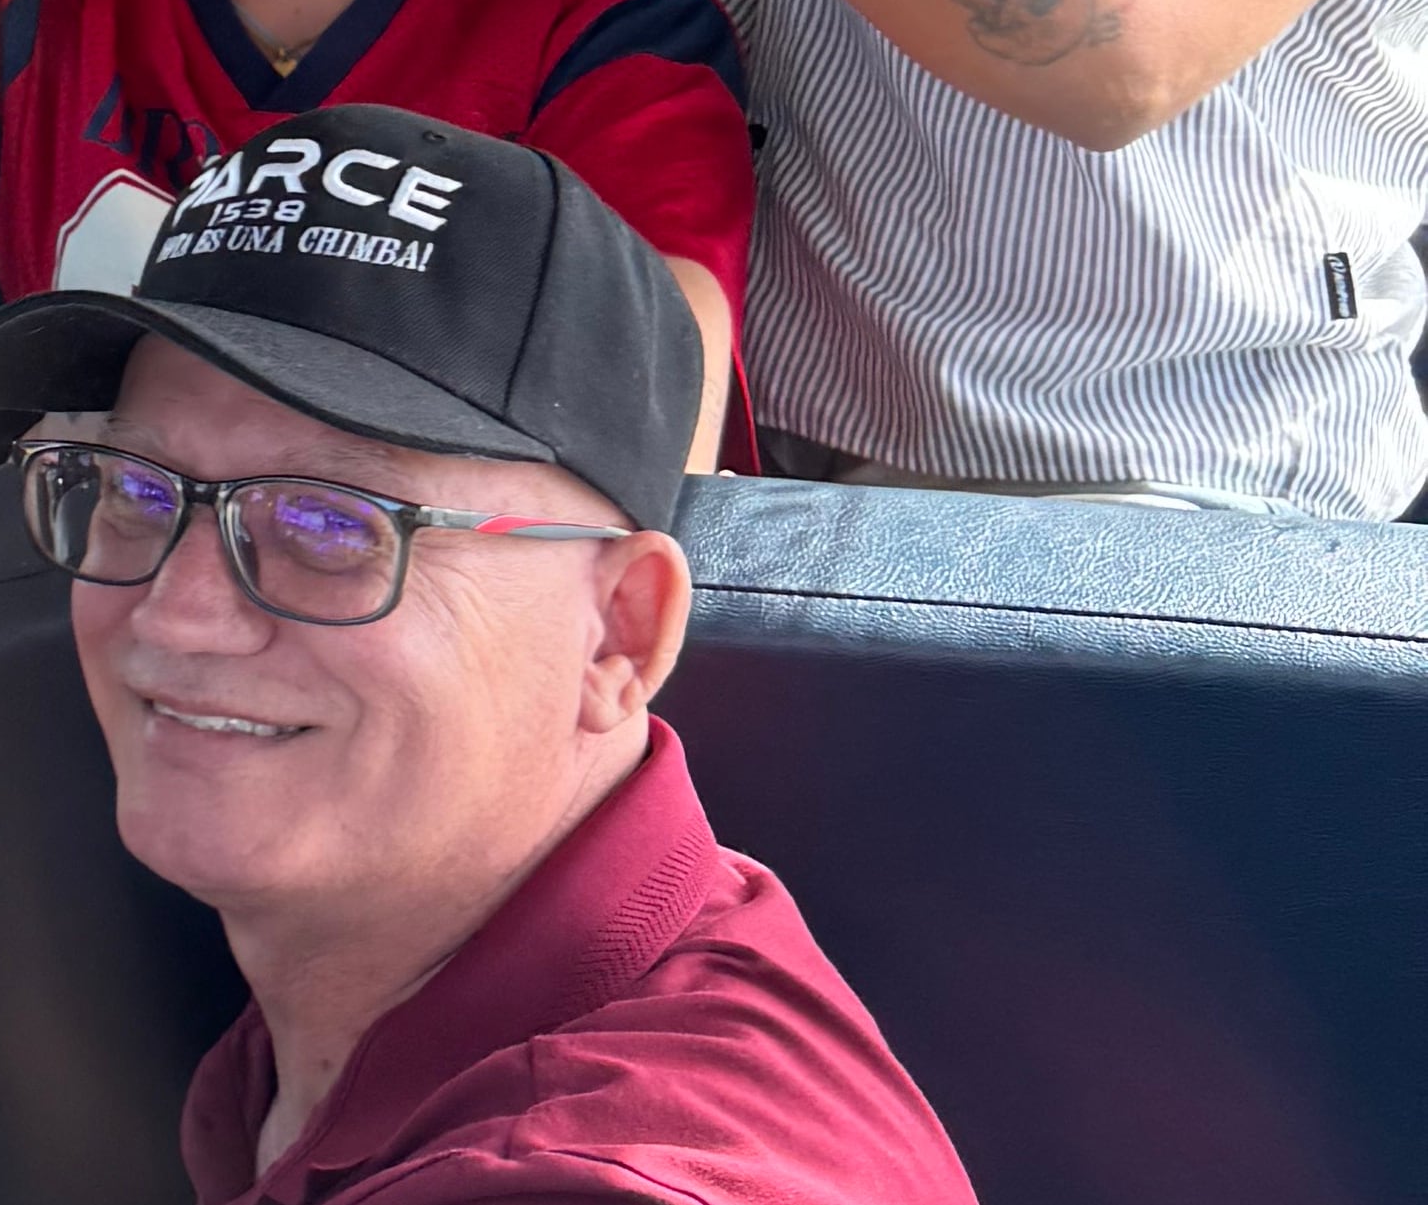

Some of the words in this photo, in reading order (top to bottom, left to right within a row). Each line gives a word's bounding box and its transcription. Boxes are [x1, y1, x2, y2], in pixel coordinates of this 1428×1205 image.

[172, 138, 463, 232] PARCE
[208, 198, 306, 228] 1538
[194, 228, 226, 254] ES
[227, 226, 286, 254] UNA
[298, 226, 434, 272] CHIMBA!
